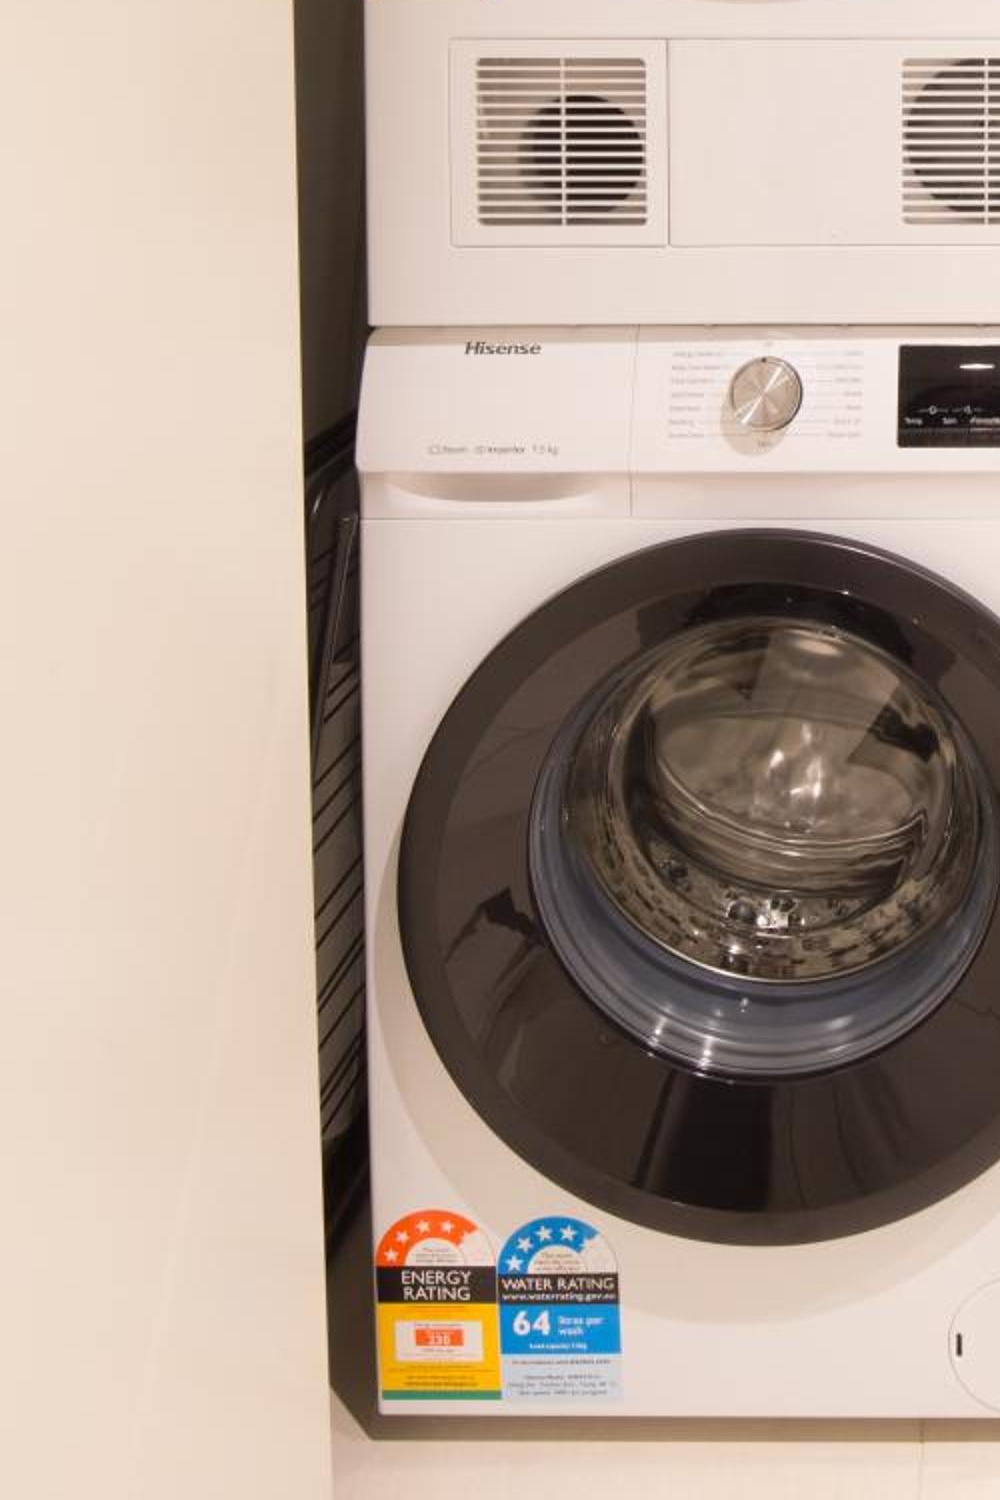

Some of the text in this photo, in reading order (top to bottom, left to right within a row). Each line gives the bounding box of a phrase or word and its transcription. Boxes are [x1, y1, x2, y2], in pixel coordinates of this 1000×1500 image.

[464, 340, 543, 356] Hisense
[400, 1269, 472, 1285] ENERGY
[501, 1277, 615, 1291] WATER RATING
[403, 1286, 471, 1301] RATING
[512, 1308, 551, 1337] 64
